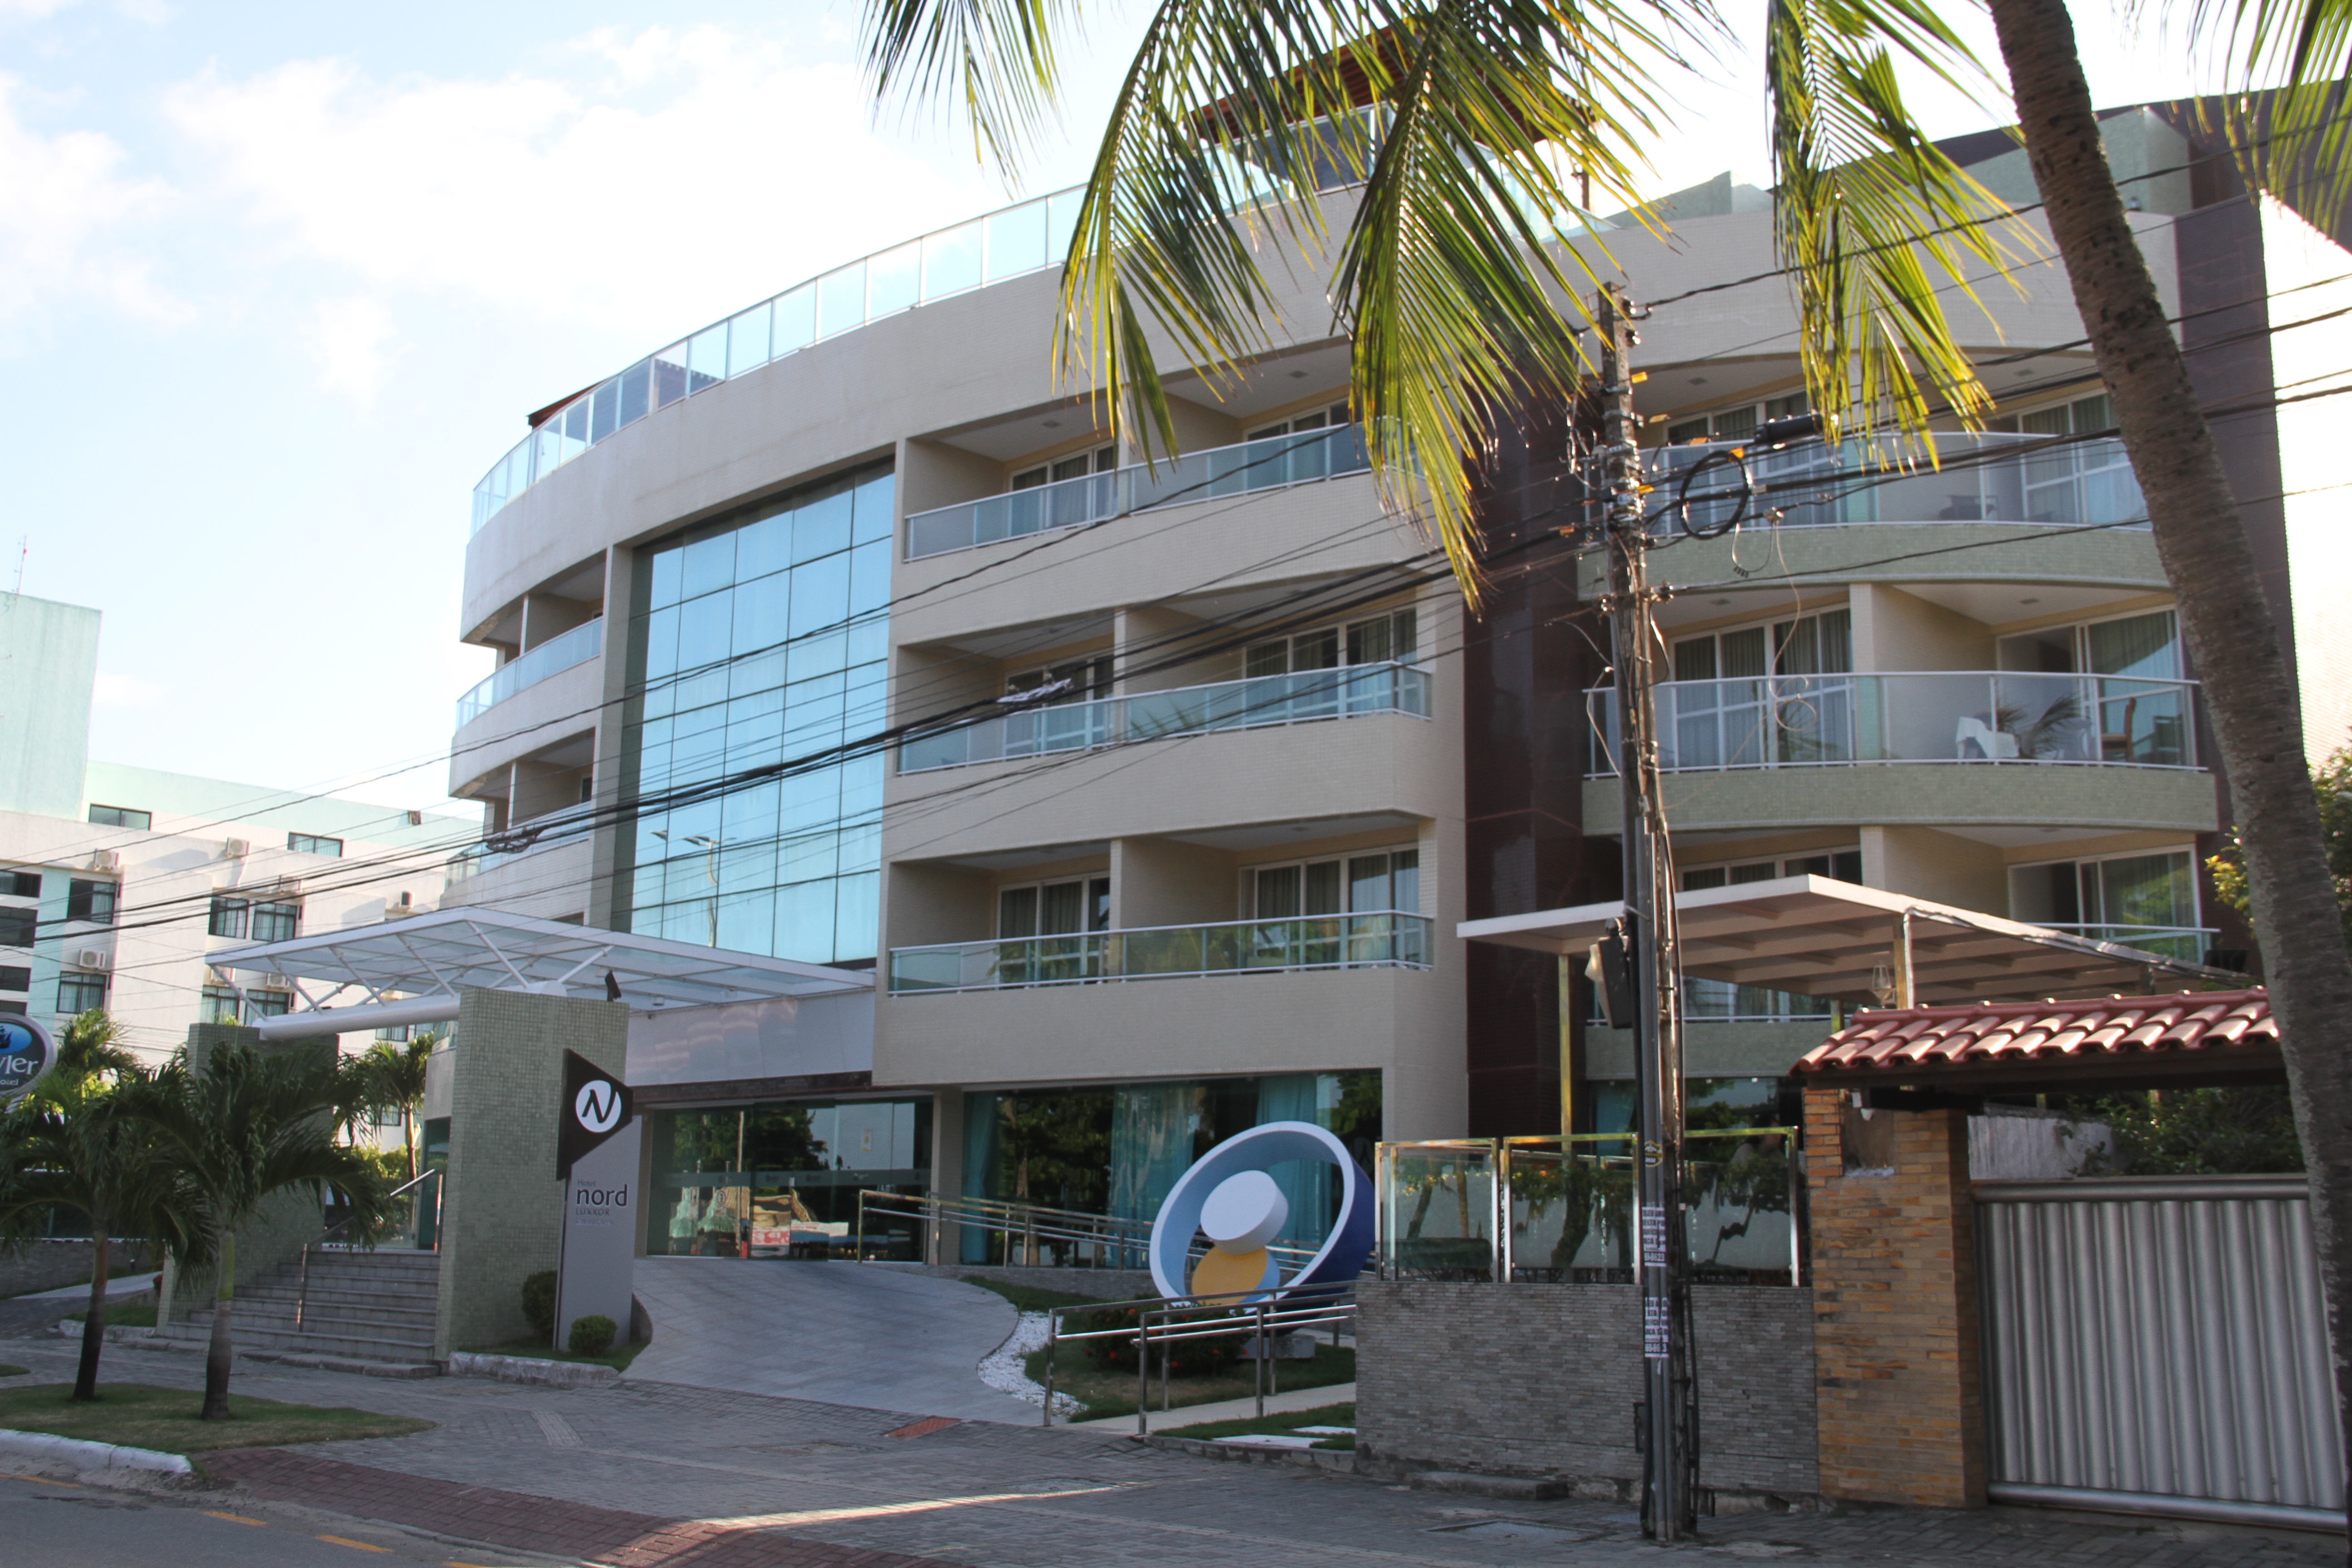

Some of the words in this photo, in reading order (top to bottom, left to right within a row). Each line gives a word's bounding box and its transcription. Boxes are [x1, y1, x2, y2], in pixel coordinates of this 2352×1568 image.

[577, 1179, 596, 1187] Hotel
[576, 1183, 628, 1207] nord
[575, 1208, 610, 1216] LUXXOR
